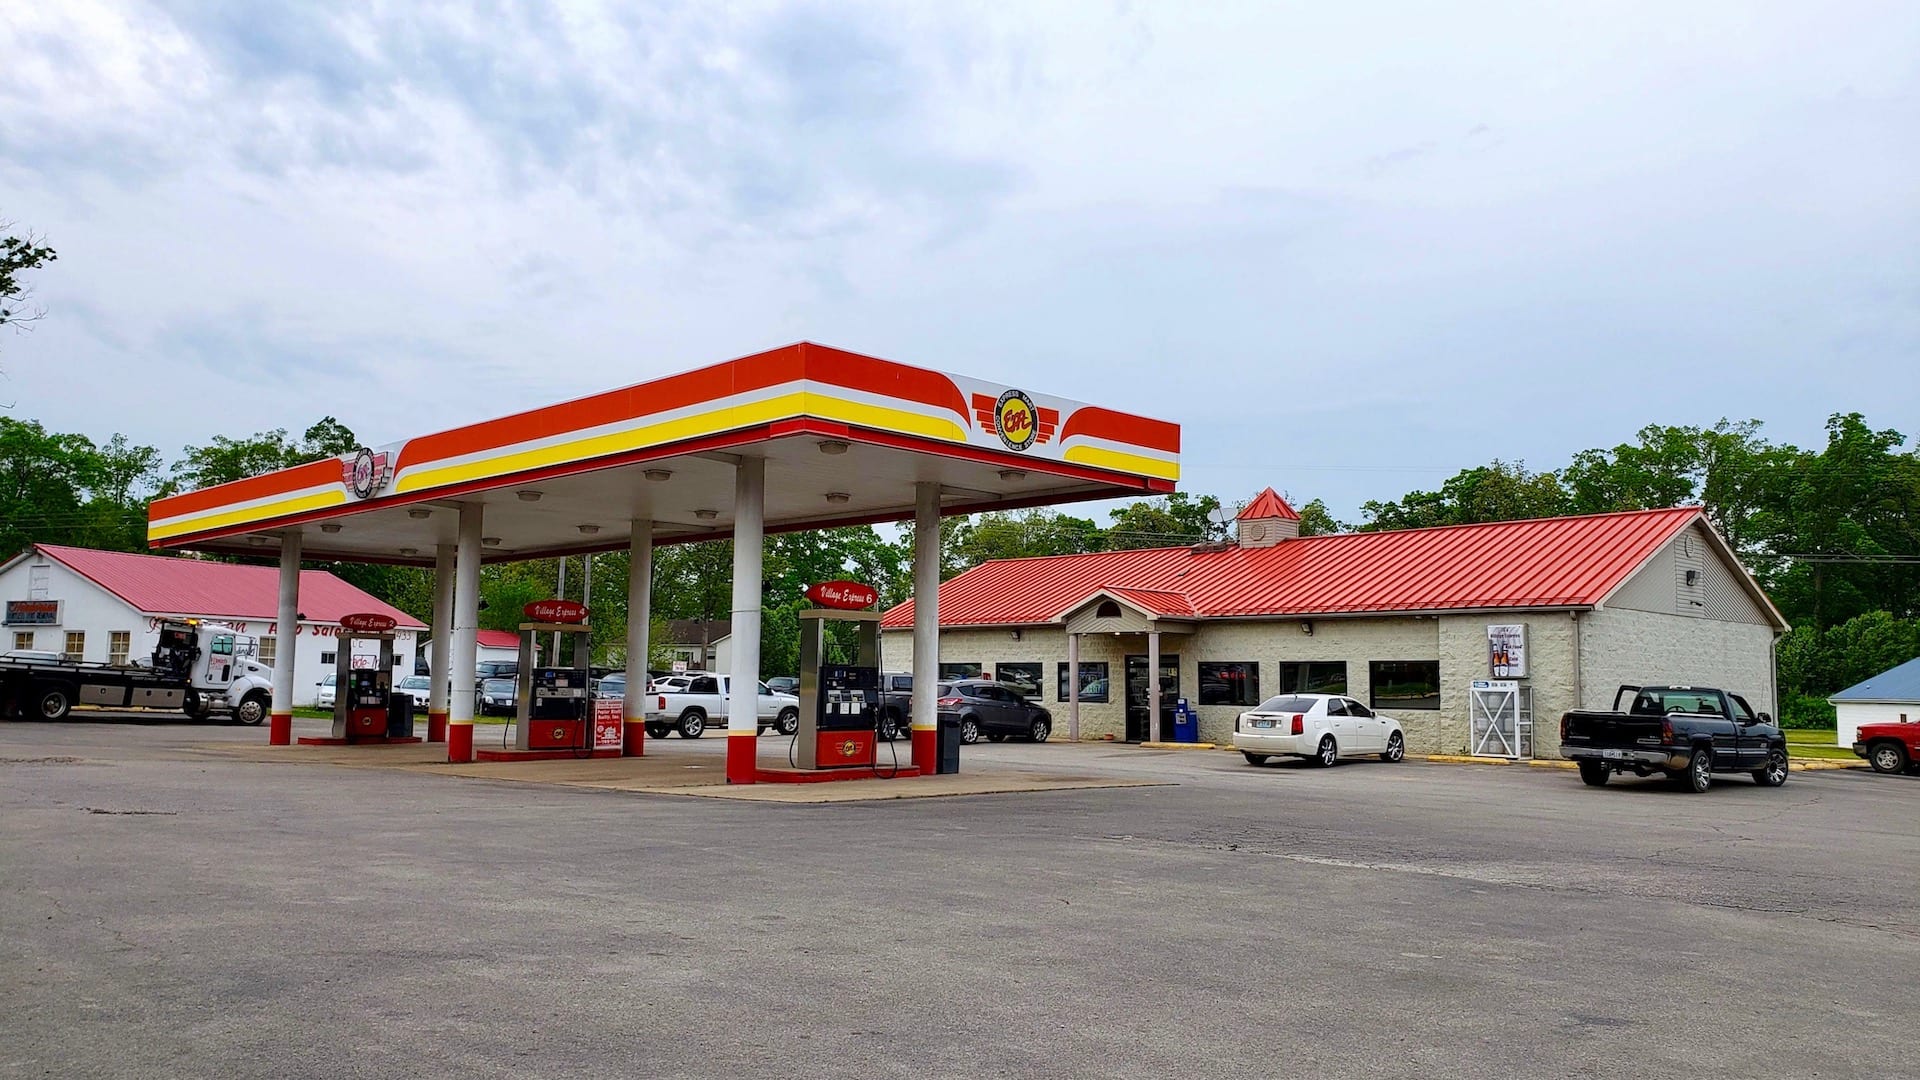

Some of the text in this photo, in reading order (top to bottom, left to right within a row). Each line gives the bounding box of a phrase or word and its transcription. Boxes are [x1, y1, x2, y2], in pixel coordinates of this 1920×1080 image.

[998, 391, 1035, 411] EXPRESS MART
[821, 585, 873, 604] Village Express 6
[535, 605, 585, 618] Village Express 4
[350, 616, 394, 628] Village Express 2
